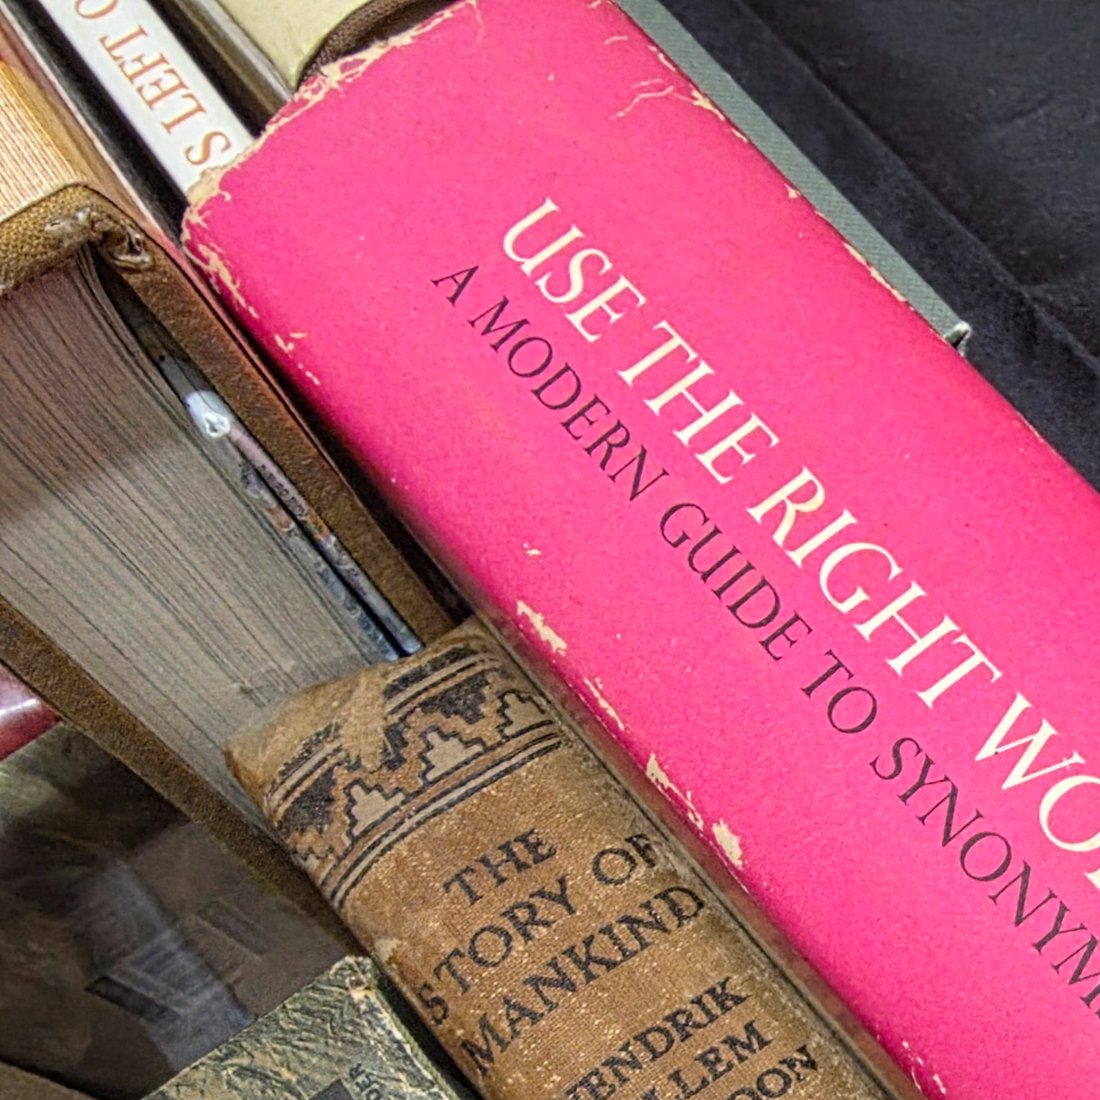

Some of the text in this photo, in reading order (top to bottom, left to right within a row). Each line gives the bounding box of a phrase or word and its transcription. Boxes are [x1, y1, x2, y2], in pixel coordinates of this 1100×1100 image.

[99, 25, 208, 134] LEFT
[431, 265, 480, 306] A
[468, 295, 670, 502] MODERN
[659, 502, 813, 662] GUIDE
[801, 649, 878, 734] TO
[502, 197, 647, 344] USE
[617, 319, 780, 485] THE
[746, 465, 1003, 709] RIGHT
[419, 832, 660, 1026] STORY OF
[443, 828, 557, 906] THE
[460, 885, 705, 1076] MANKIND
